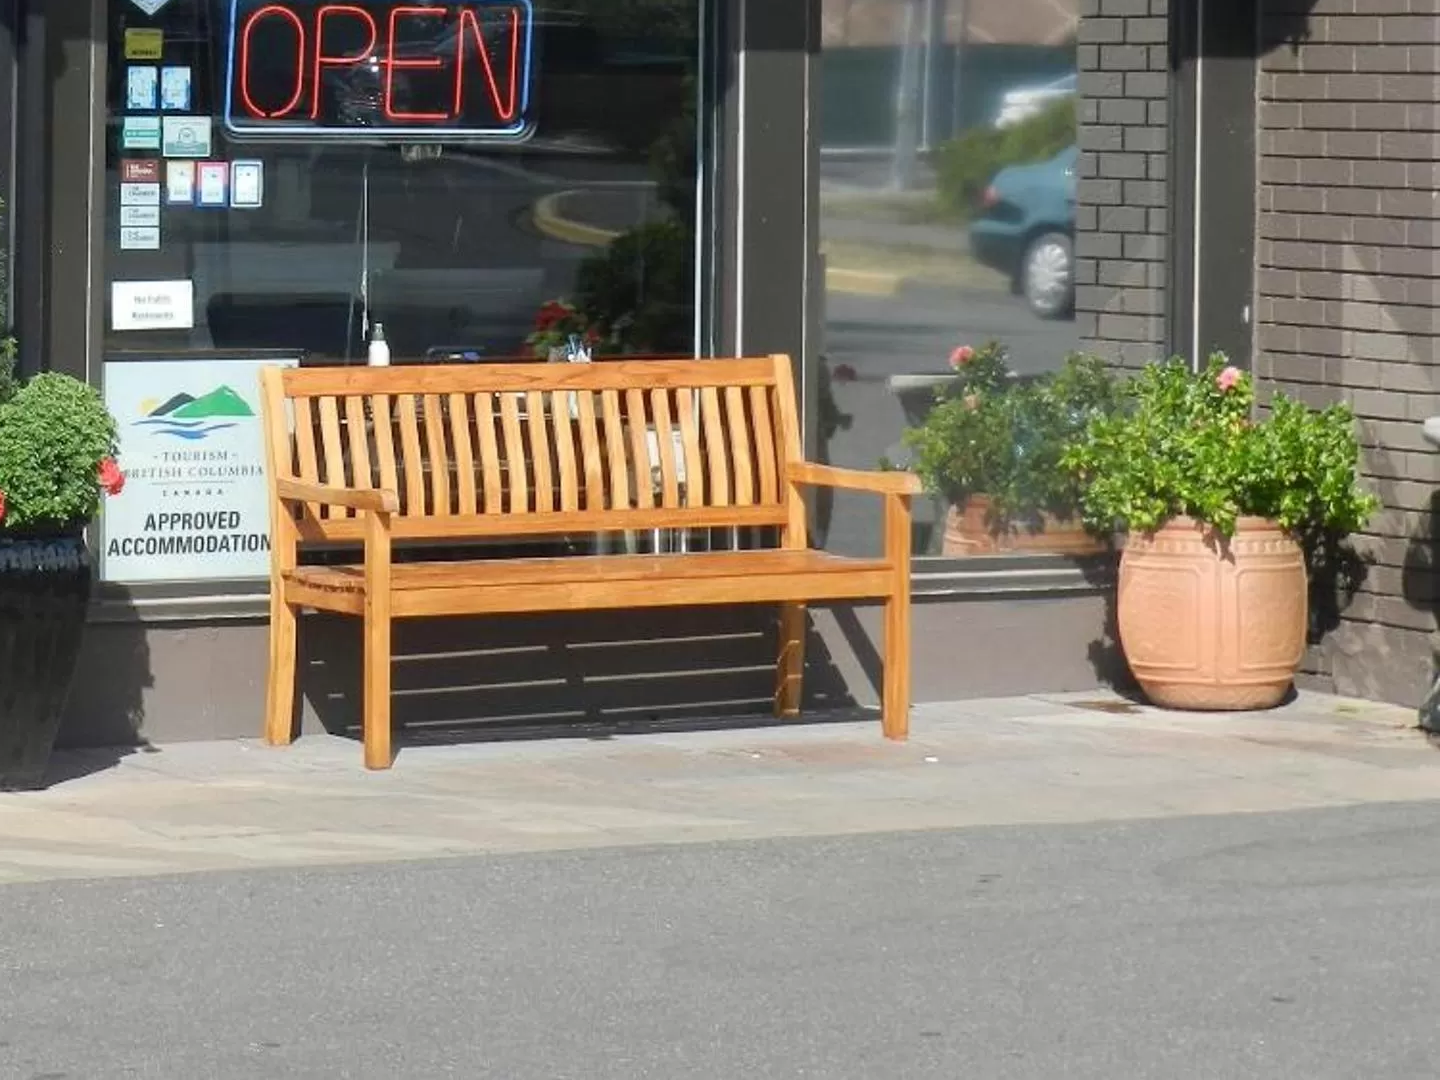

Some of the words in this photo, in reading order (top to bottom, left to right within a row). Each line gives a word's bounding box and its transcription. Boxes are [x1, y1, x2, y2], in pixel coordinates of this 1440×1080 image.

[241, 4, 520, 120] OPEN
[162, 450, 228, 463] TOURISM
[124, 466, 182, 479] BRITISH
[188, 464, 265, 478] COLUMBIA
[162, 488, 224, 497] CANADA
[143, 510, 241, 532] APPROVED
[107, 533, 272, 557] ACCOMMODATION
